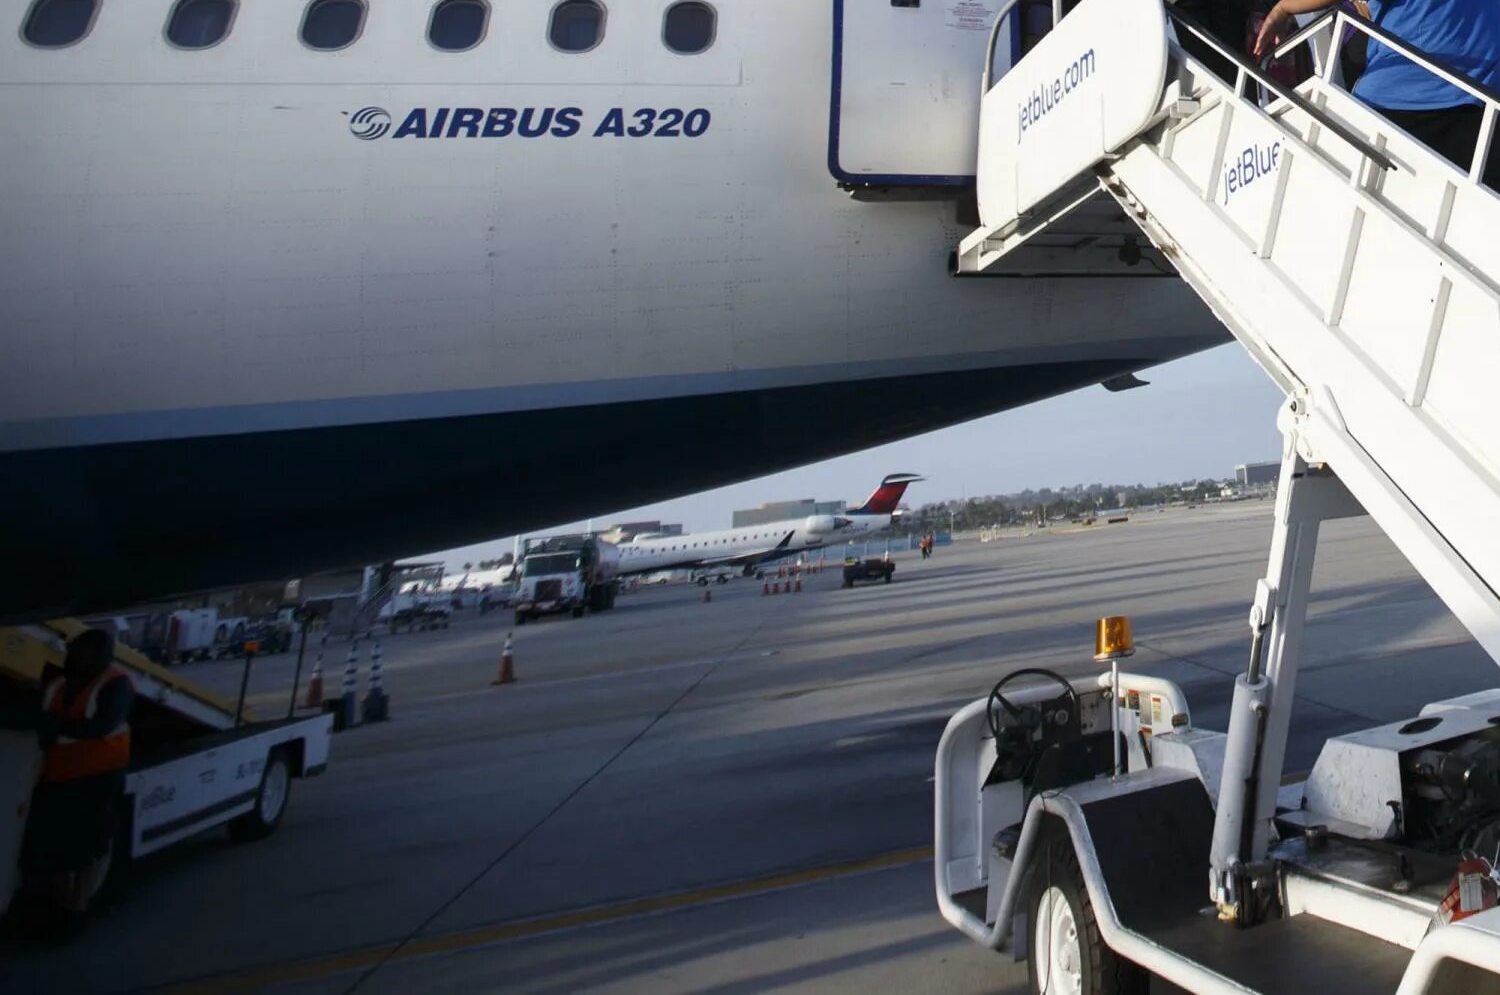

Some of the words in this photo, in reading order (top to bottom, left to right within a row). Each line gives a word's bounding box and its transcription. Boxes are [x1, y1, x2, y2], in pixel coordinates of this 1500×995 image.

[391, 106, 585, 140] AIRBUS
[592, 106, 712, 139] A320
[1017, 47, 1096, 146] jetblue.com
